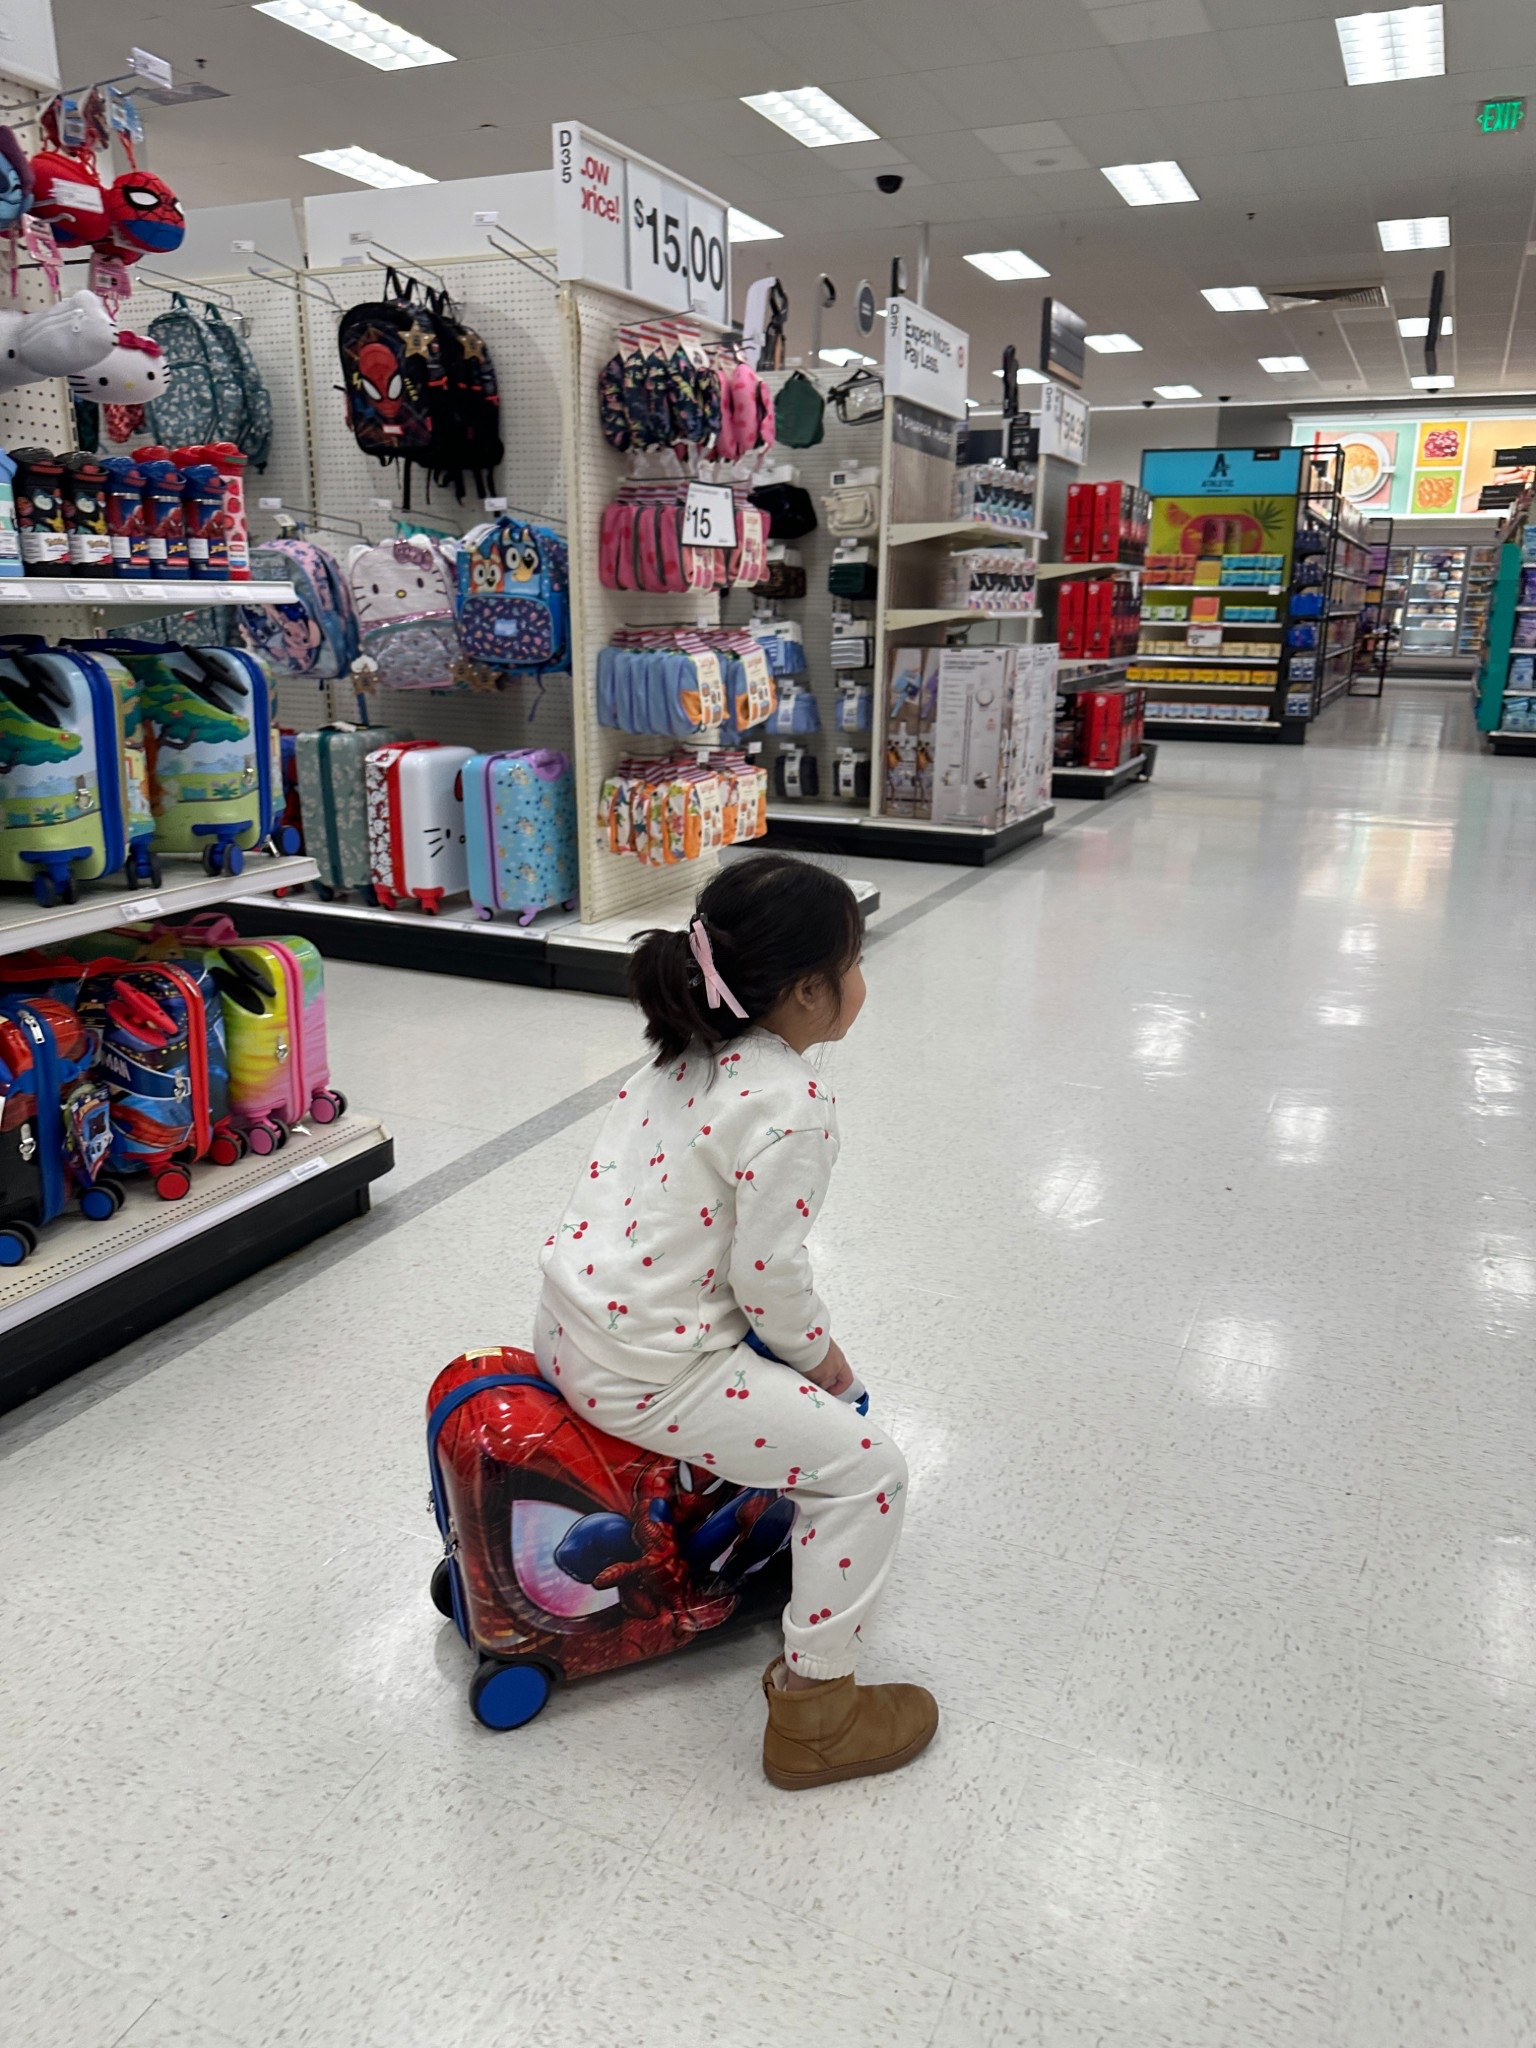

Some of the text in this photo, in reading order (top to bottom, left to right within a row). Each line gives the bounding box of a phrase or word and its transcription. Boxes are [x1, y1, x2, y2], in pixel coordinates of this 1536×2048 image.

[1482, 101, 1522, 133] EXIT
[580, 156, 610, 186] ow
[634, 197, 723, 291] $15.00
[905, 316, 932, 346] Expect
[904, 339, 919, 369] Pay
[686, 504, 712, 539] $15
